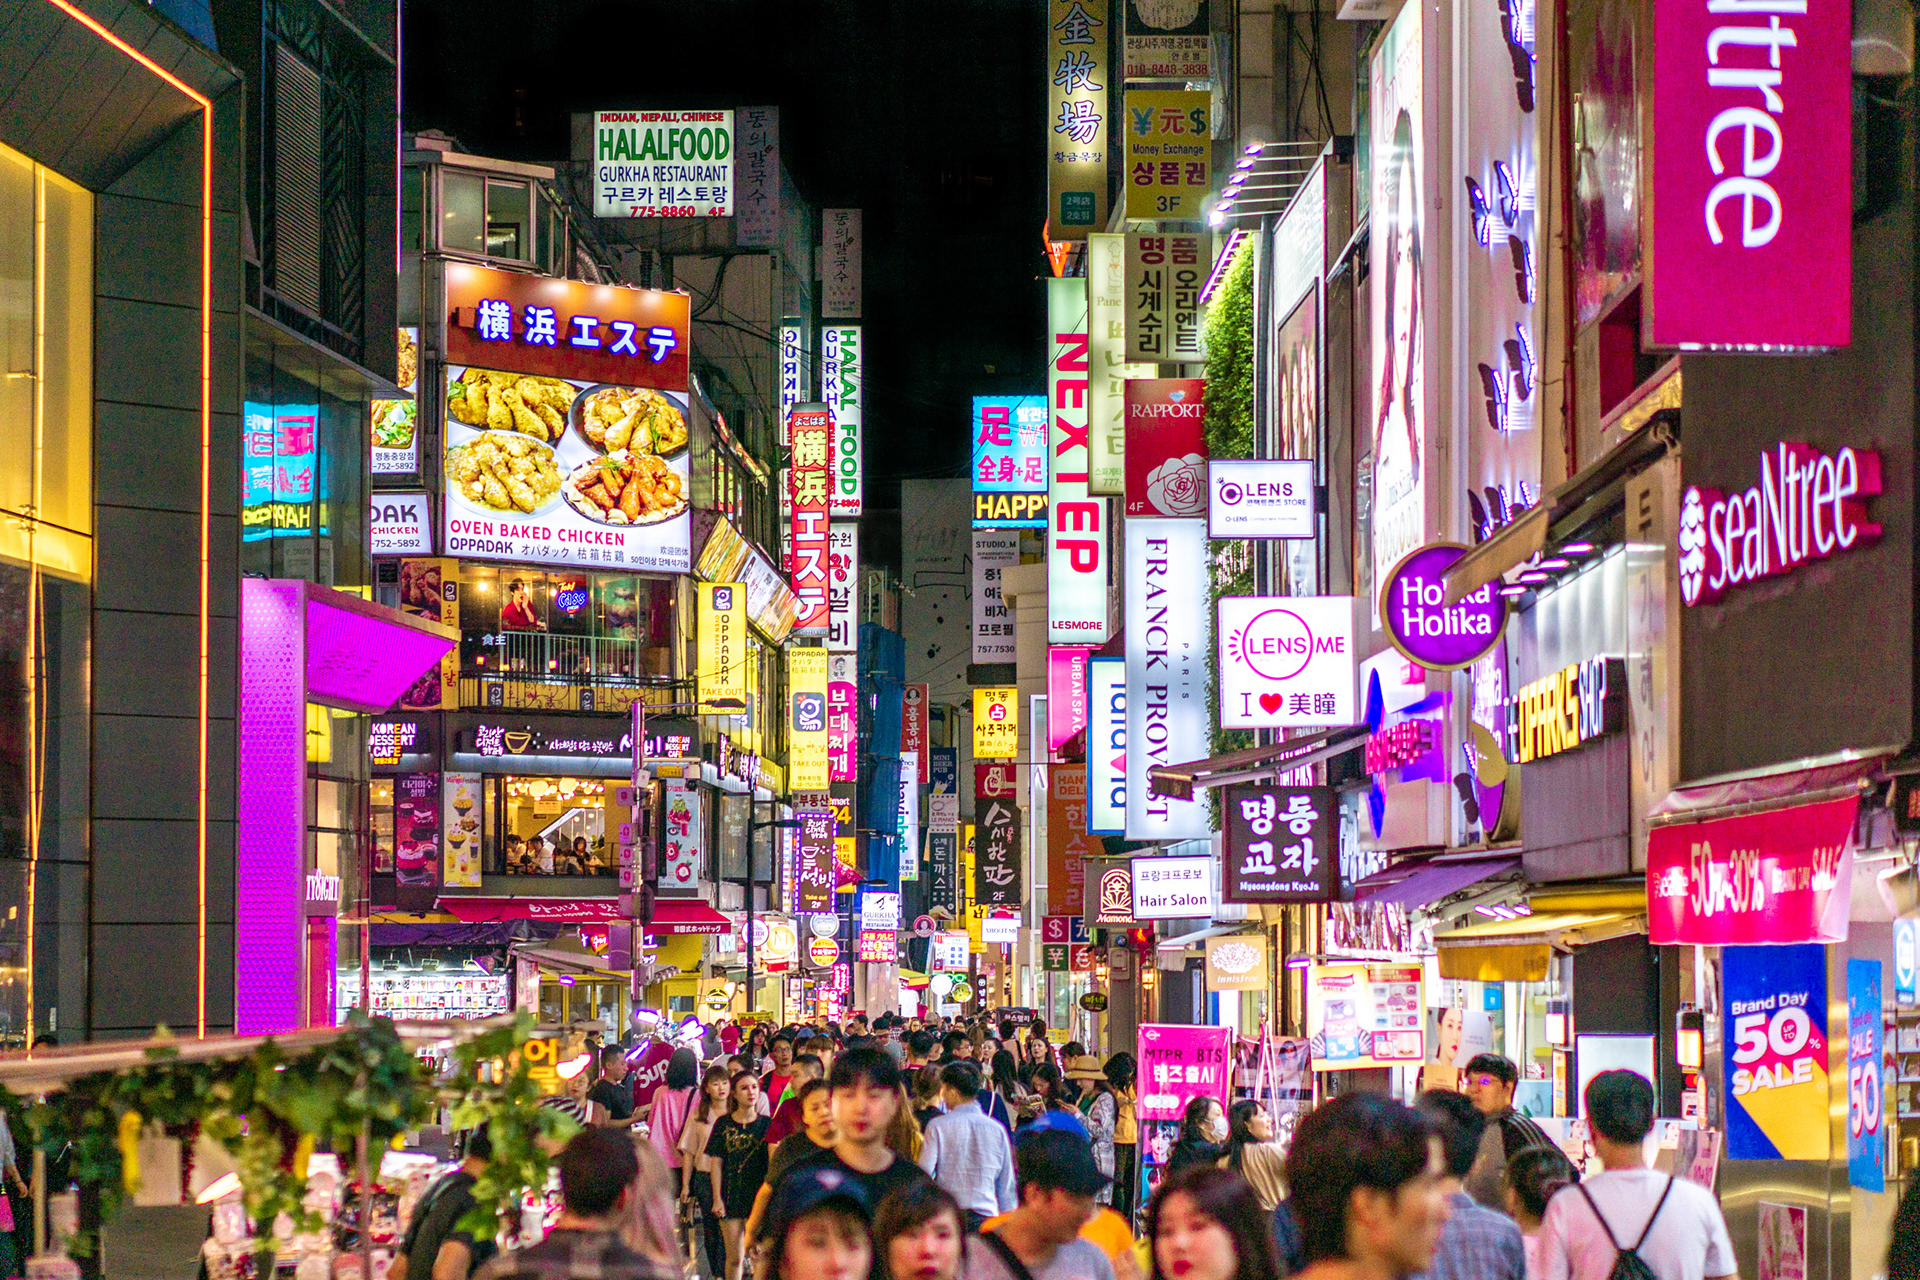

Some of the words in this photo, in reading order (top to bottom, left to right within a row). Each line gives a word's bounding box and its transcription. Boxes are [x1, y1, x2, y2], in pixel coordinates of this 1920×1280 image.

[1054, 0, 1103, 144] 金牧場
[600, 113, 639, 123] INDIAN,
[641, 113, 680, 123] NEPALI,
[682, 112, 724, 122] CHINESE
[1132, 144, 1159, 156] Money
[1163, 144, 1204, 156] Exchange
[600, 166, 650, 182] GURKHA
[653, 166, 728, 182] RESTAURANT
[1132, 162, 1206, 186] 상품권
[602, 187, 655, 203] 구르카
[660, 186, 728, 203] 레스토랑
[630, 206, 696, 217] 775-8860
[708, 206, 725, 217] 4F
[1156, 196, 1181, 212] 3F
[1139, 237, 1198, 265] 명품
[1138, 271, 1162, 354] 시계수리
[1175, 270, 1198, 353] 오리엔트
[479, 300, 675, 362] 横浜エステ
[840, 330, 857, 411] HALAL
[1131, 404, 1203, 417] RAPPORT
[795, 417, 826, 426] よこはま
[977, 406, 1012, 446] 足
[376, 453, 414, 461] 명동중앙점
[840, 425, 857, 495] FOOD
[975, 495, 1048, 519] HAPP
[1129, 503, 1144, 512] 4F
[1709, 441, 1857, 590] seaNtree
[450, 520, 493, 536] OVEN
[500, 523, 551, 541] BAKED
[559, 528, 625, 546] CHICKEN
[794, 430, 828, 621] 横浜エステ
[450, 537, 513, 554] OPPADAK
[1146, 537, 1168, 671] FRANCK
[978, 624, 1014, 636] 프로필
[1052, 621, 1102, 630] LESMORE
[1402, 608, 1491, 636] Holika
[721, 614, 729, 685] OPPADAK
[1250, 637, 1307, 654] LENS
[1316, 637, 1344, 653] ME
[1071, 656, 1082, 697] URBAN
[991, 705, 1004, 720] 占
[1240, 692, 1252, 717] I
[1289, 692, 1336, 715] 美瞳
[372, 723, 417, 735] KOREAN
[665, 743, 689, 751] DESSERT
[667, 736, 690, 744] KOREAN
[373, 746, 402, 757] CAFE
[800, 794, 828, 807] 부동산
[1240, 794, 1319, 835] 명동
[1240, 837, 1319, 876] 교자
[934, 847, 946, 889] 돈까스
[1141, 870, 1203, 882] 프랑크프로보
[1240, 881, 1289, 891] Myeongdong
[993, 891, 1005, 900] 2F
[1140, 896, 1167, 907] Hair
[1171, 894, 1207, 906] Salon
[1096, 914, 1137, 923] Mamond
[1732, 996, 1776, 1015] Brand
[1779, 992, 1809, 1007] Day
[1783, 1025, 1794, 1033] UP
[1784, 1032, 1795, 1040] TO
[1197, 1049, 1223, 1063] BTS
[1185, 1065, 1214, 1083] 출시
[1732, 1057, 1813, 1096] SALE
[1851, 1061, 1879, 1139] 50
